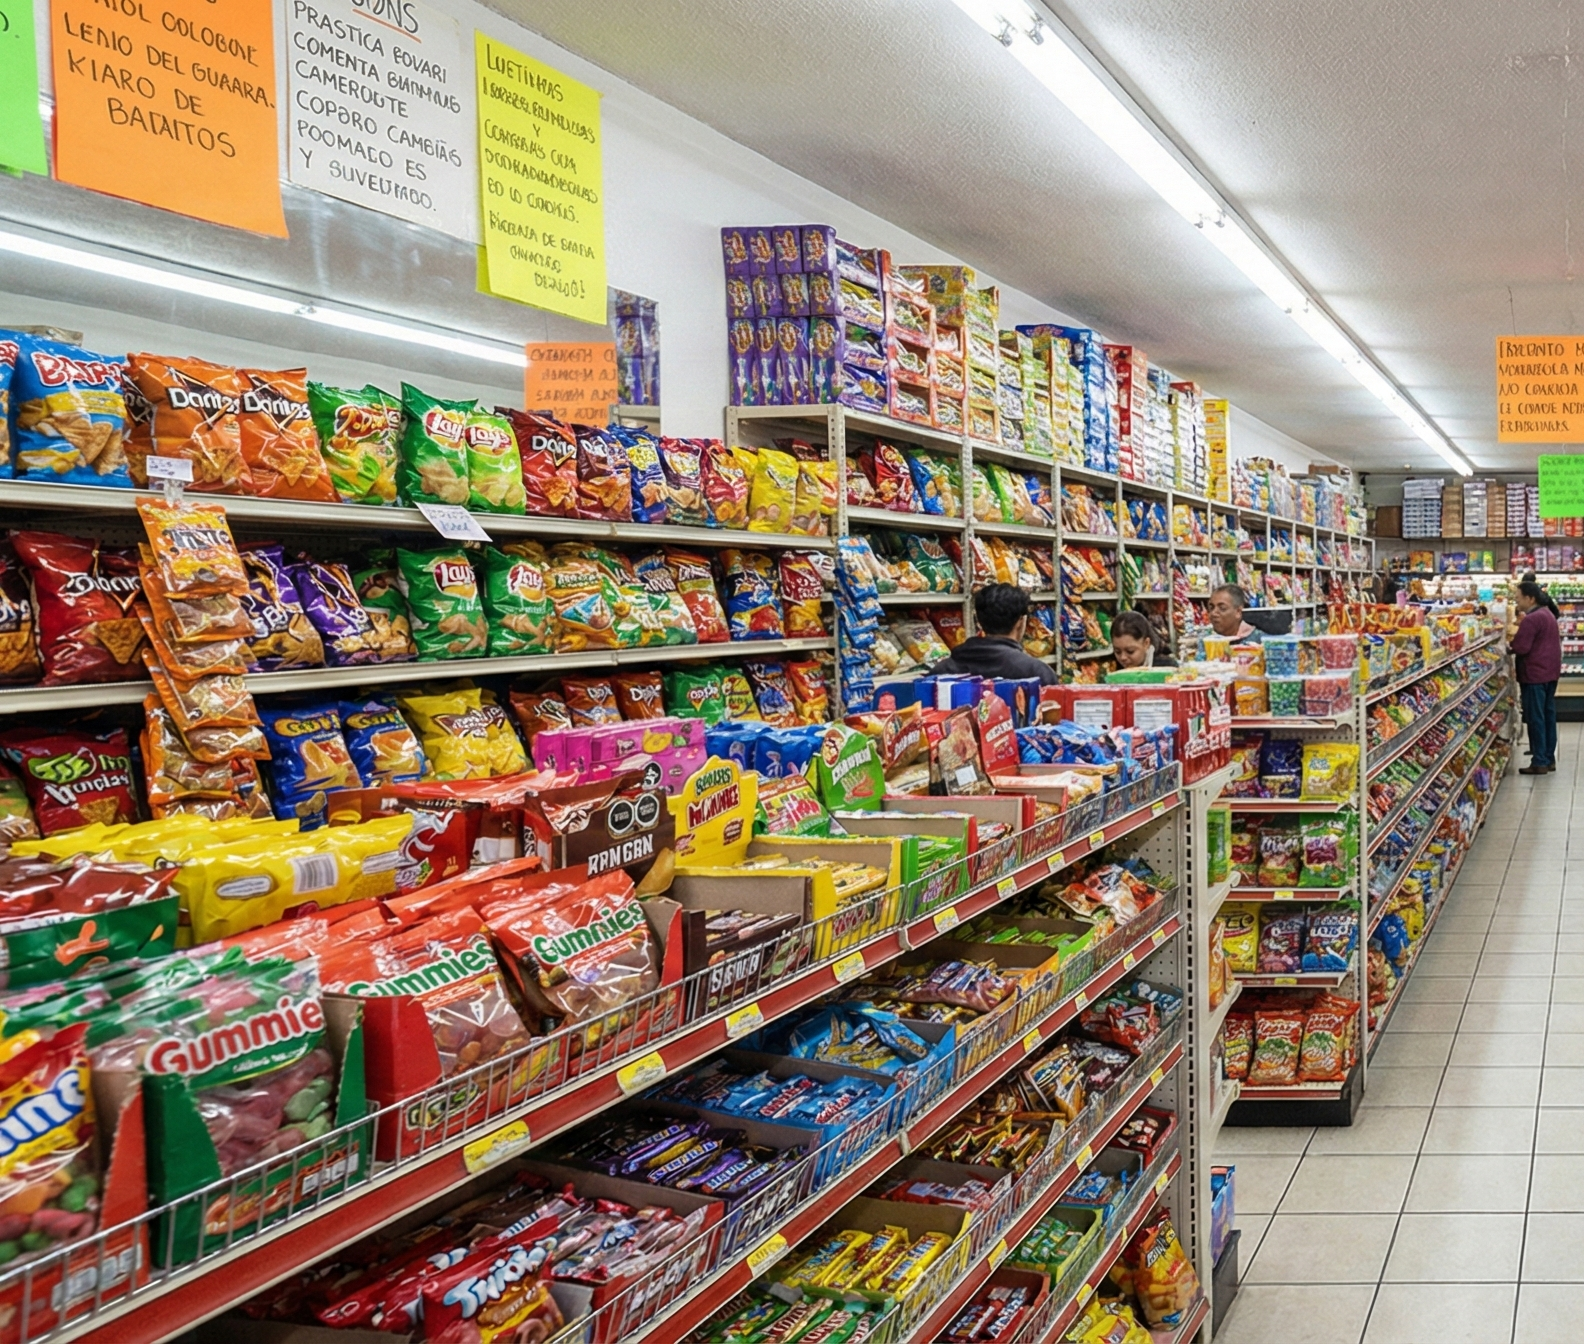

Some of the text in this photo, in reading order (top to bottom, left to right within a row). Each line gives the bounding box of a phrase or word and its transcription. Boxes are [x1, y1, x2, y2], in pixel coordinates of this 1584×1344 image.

[146, 44, 186, 76] DEL
[293, 31, 380, 82] COMENTA
[67, 48, 206, 117] KIARO DE
[532, 122, 541, 138] Y
[299, 147, 313, 169] Y
[405, 158, 428, 181] ES
